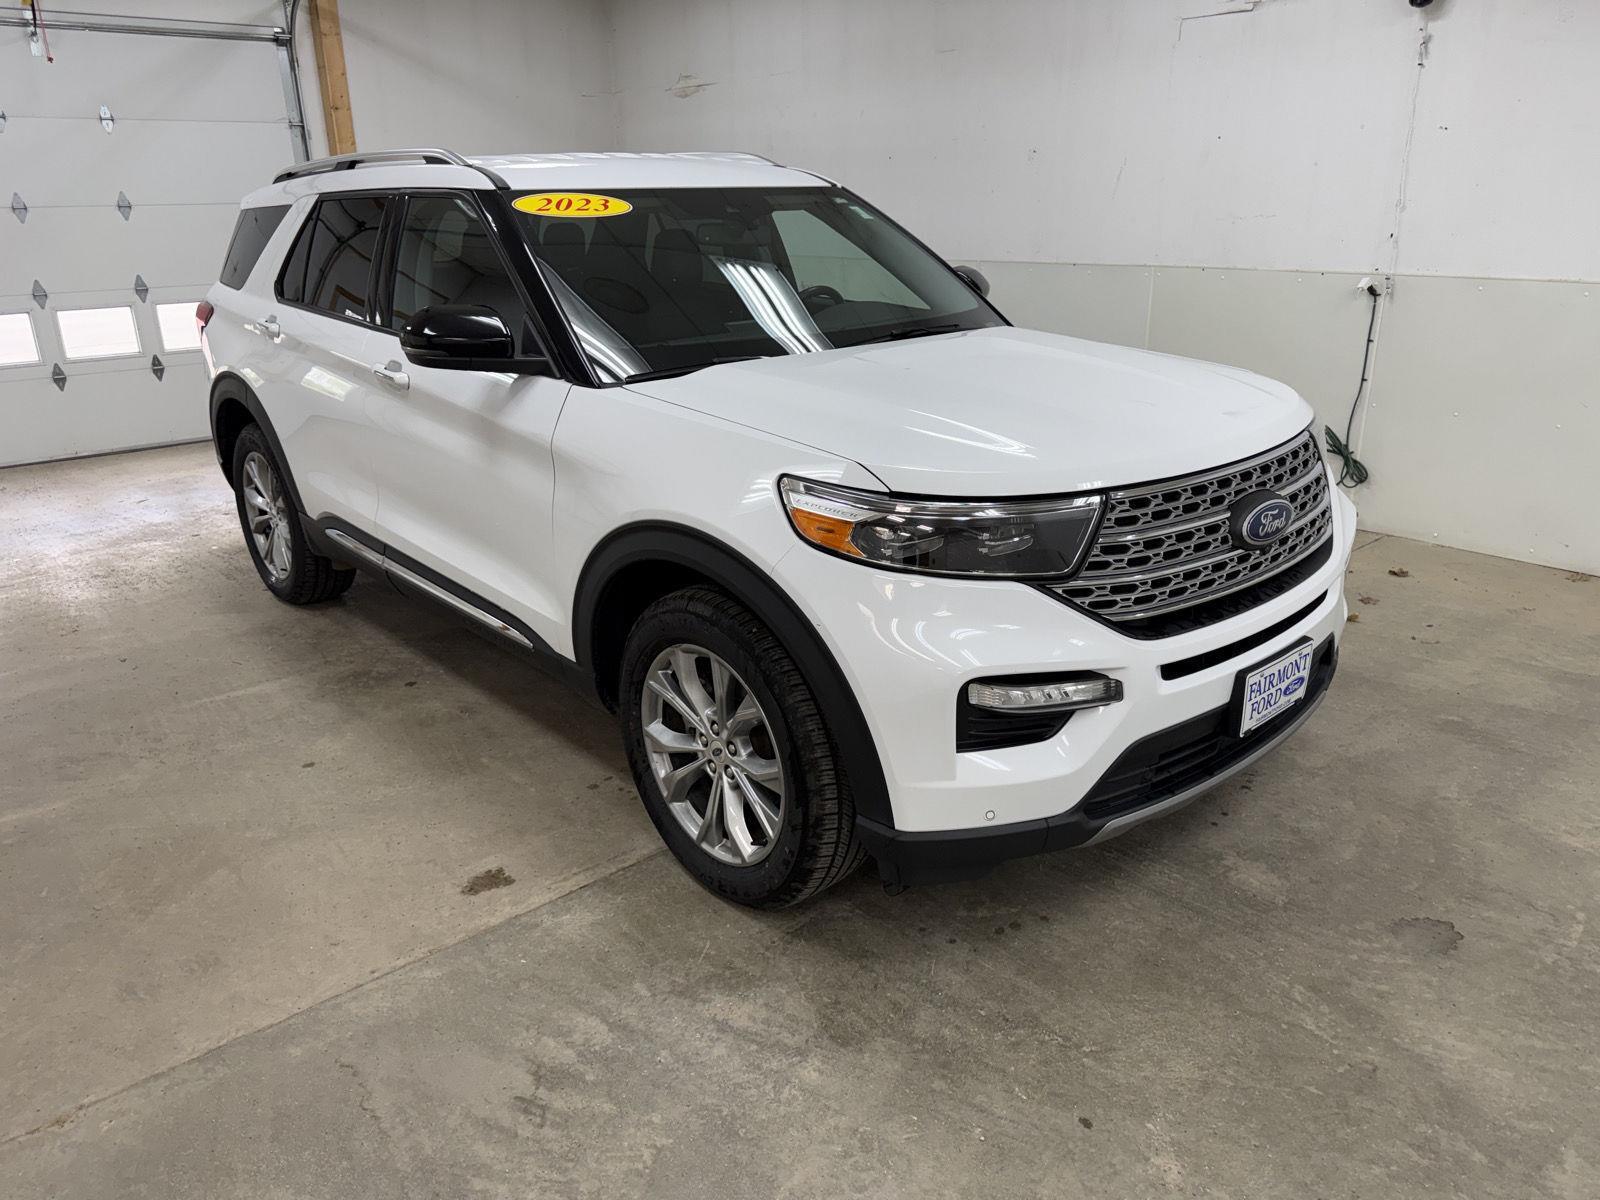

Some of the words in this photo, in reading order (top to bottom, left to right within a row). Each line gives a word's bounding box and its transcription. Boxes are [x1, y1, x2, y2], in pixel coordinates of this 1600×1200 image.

[535, 197, 610, 212] 2023
[1259, 508, 1287, 537] Ford
[1247, 653, 1310, 702] FAIRMONT
[1249, 687, 1283, 721] FORD
